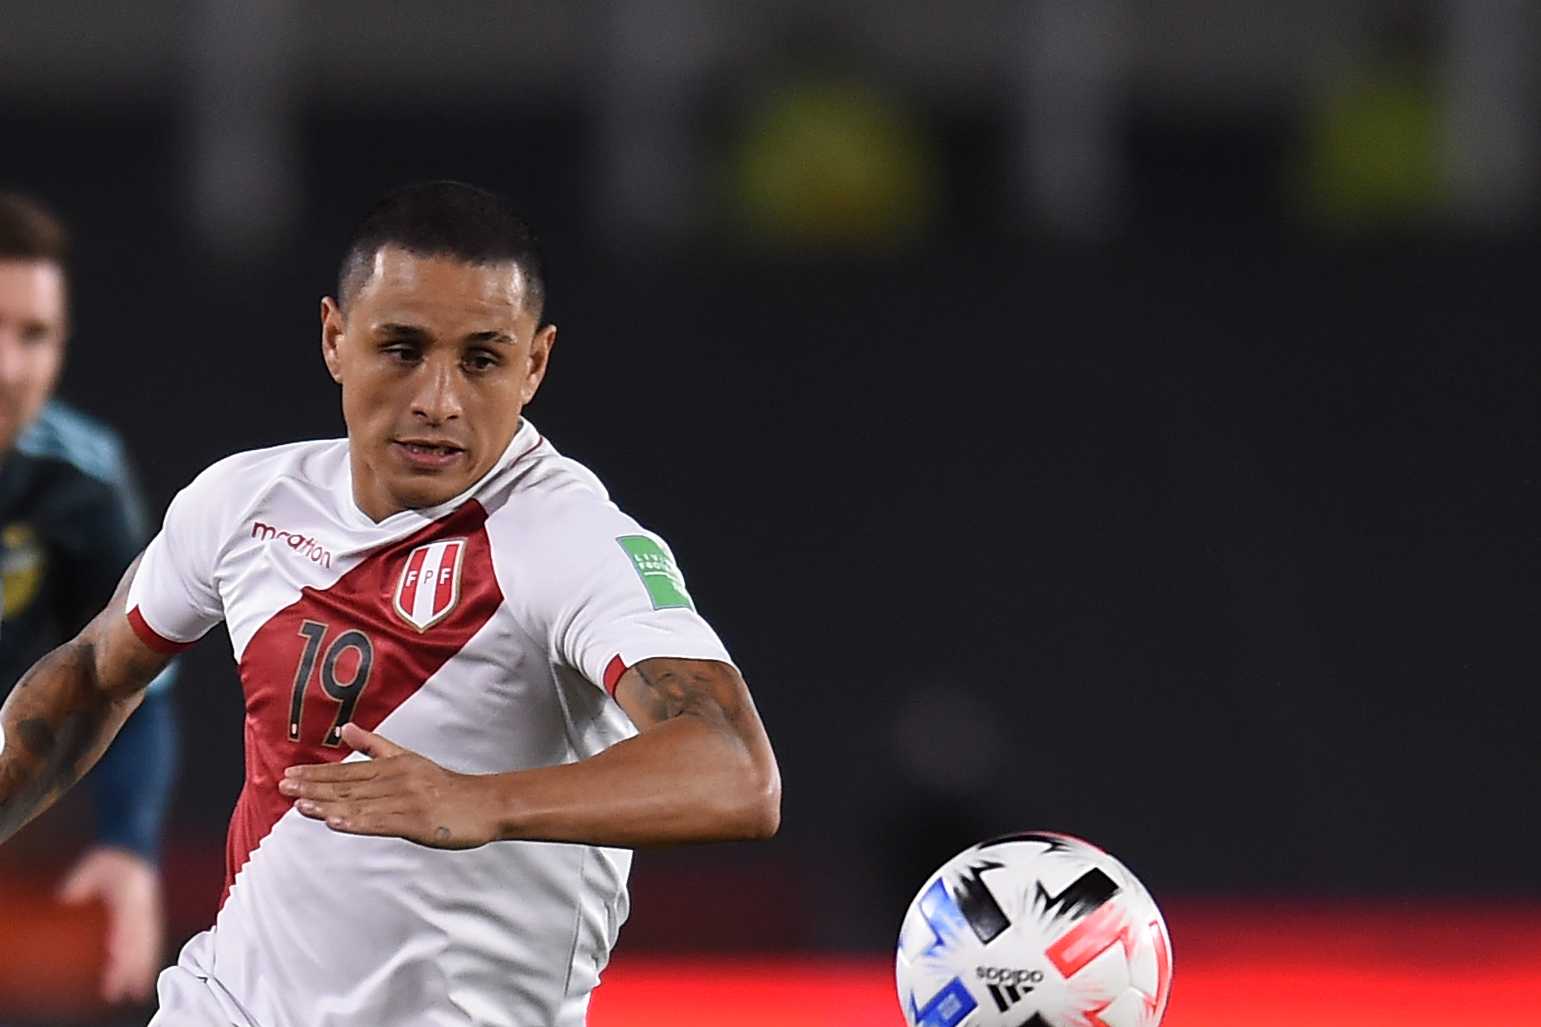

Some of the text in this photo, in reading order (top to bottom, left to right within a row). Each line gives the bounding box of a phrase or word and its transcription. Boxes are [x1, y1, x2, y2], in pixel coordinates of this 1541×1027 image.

[405, 567, 451, 587] FPF
[287, 619, 374, 748] 19
[976, 966, 1044, 984] adidas
